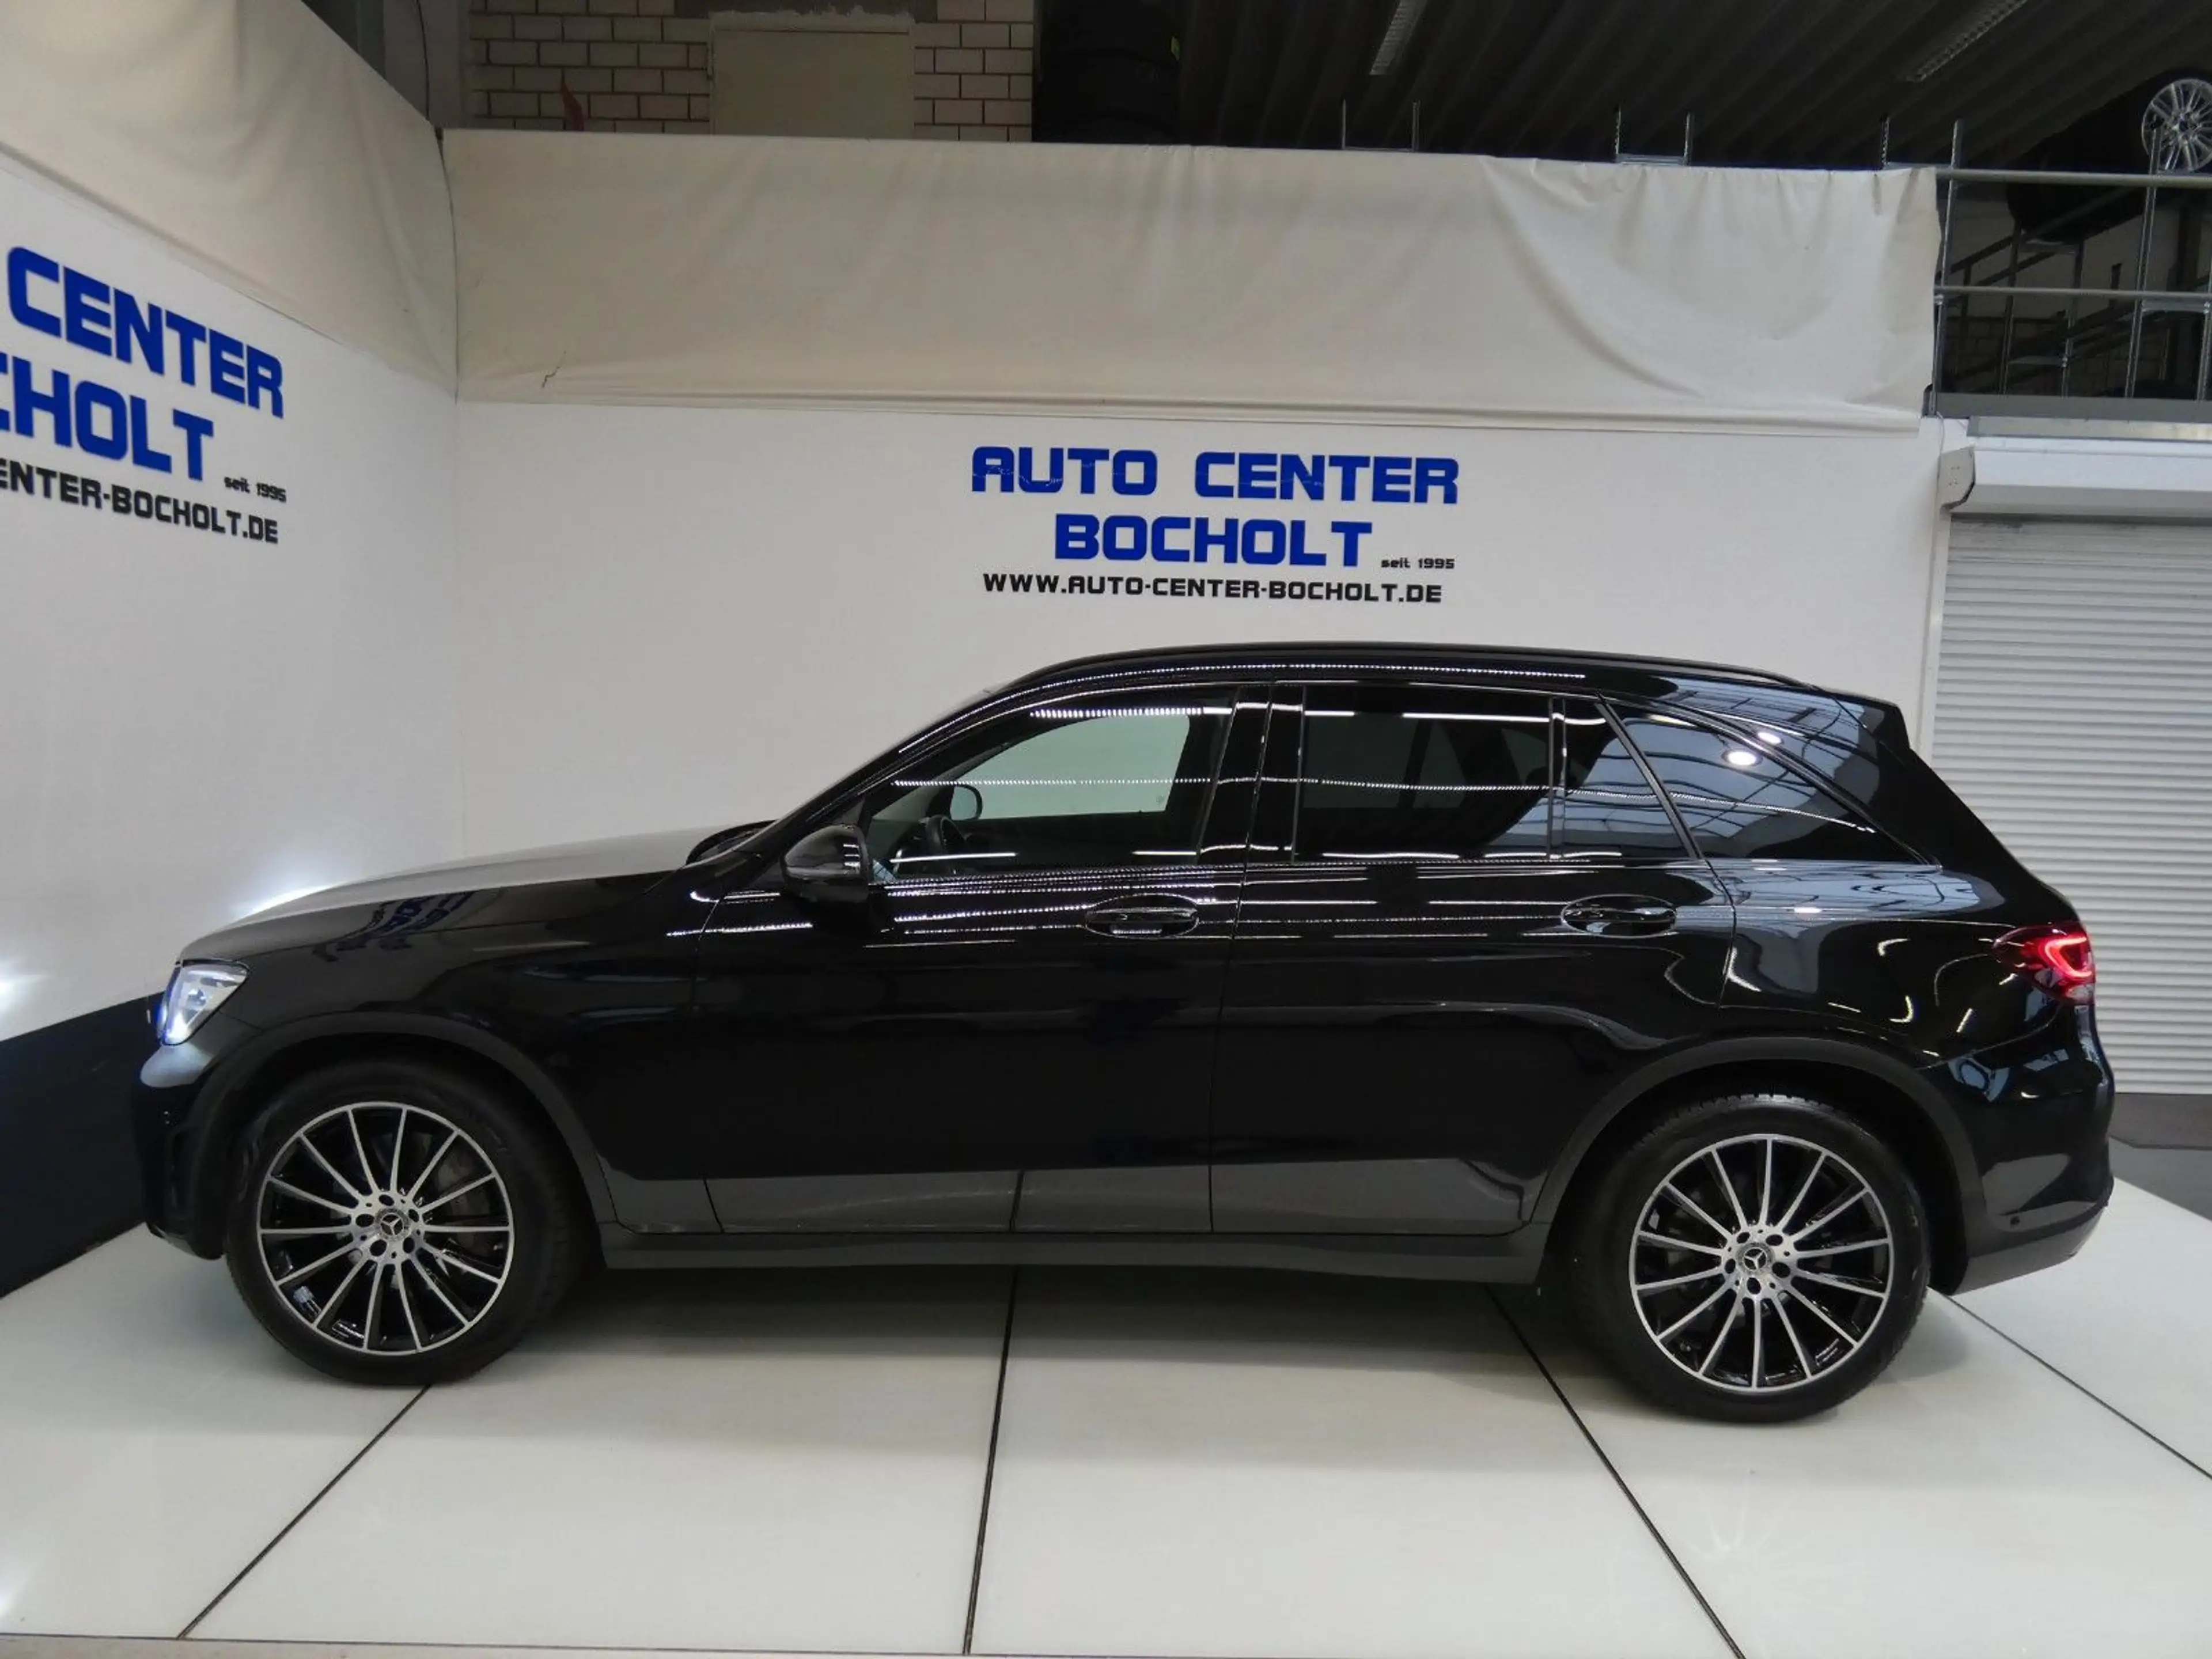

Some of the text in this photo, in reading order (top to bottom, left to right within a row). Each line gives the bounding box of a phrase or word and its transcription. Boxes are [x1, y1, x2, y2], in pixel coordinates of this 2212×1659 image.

[7, 247, 285, 420] CENTER
[0, 352, 287, 503] HOLT seit 1995
[972, 446, 1460, 505] AUTO CENTER
[1055, 513, 1456, 570] BOCHOLT seit 1995
[983, 573, 1442, 604] WWW.AUTO-CENTER-BOCHOLT.DE
